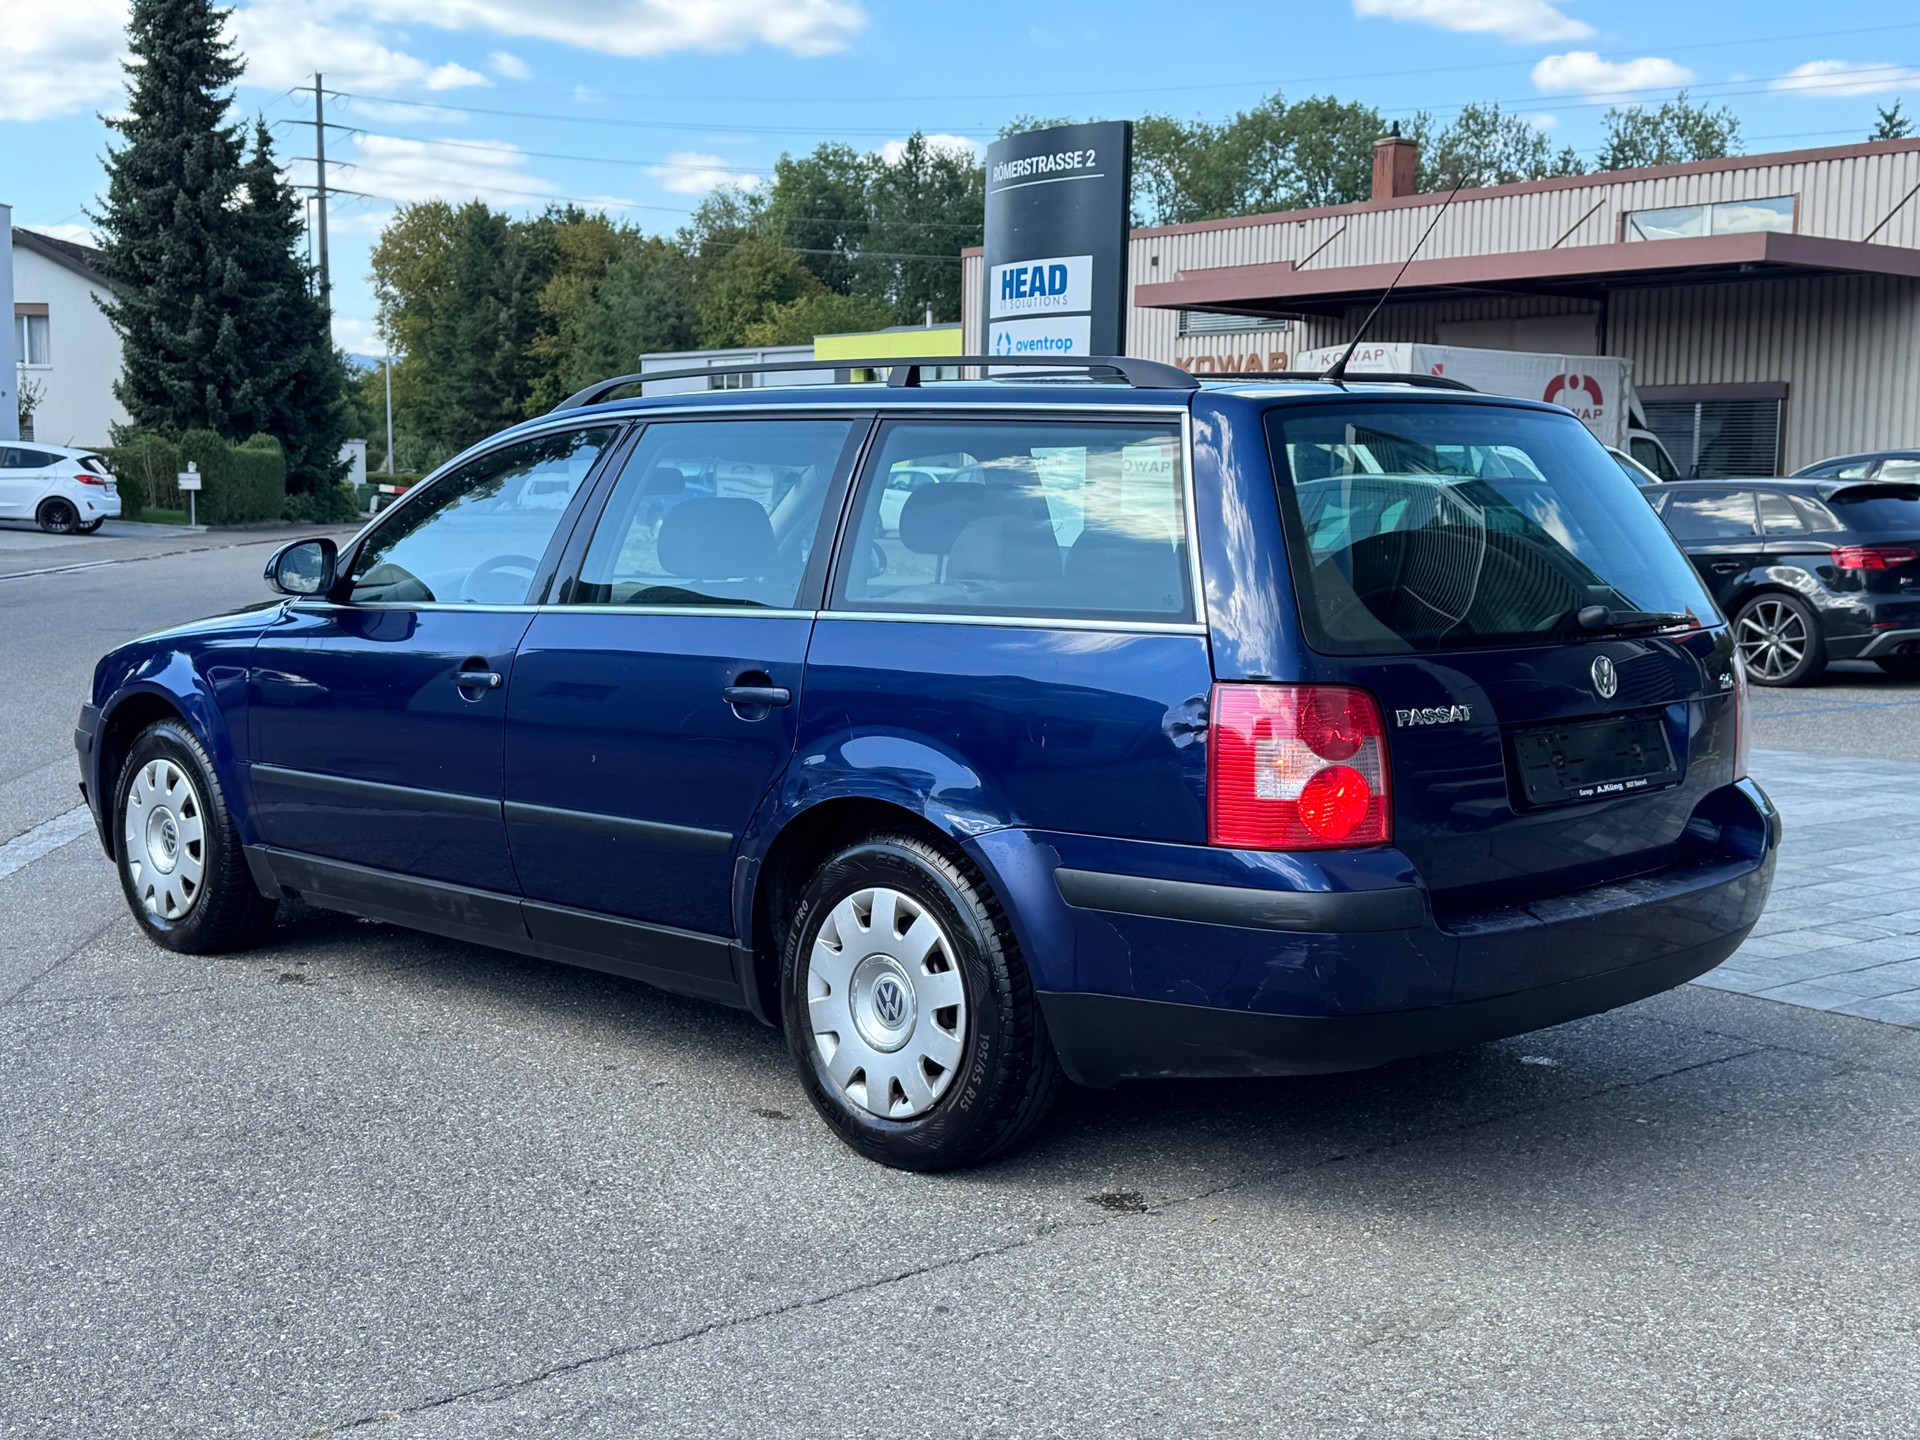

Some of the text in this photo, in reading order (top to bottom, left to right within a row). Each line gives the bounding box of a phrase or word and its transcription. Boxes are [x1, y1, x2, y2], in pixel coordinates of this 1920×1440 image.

[993, 149, 1096, 183] RÖMERSTRASSE 2
[1002, 264, 1068, 301] HEAD
[1009, 295, 1068, 310] SOLUTIONS
[1016, 336, 1073, 354] oventrop
[1395, 704, 1473, 728] PASSAT
[783, 900, 809, 977] SPIRIT PRO
[959, 1033, 990, 1112] 195/65 R15
